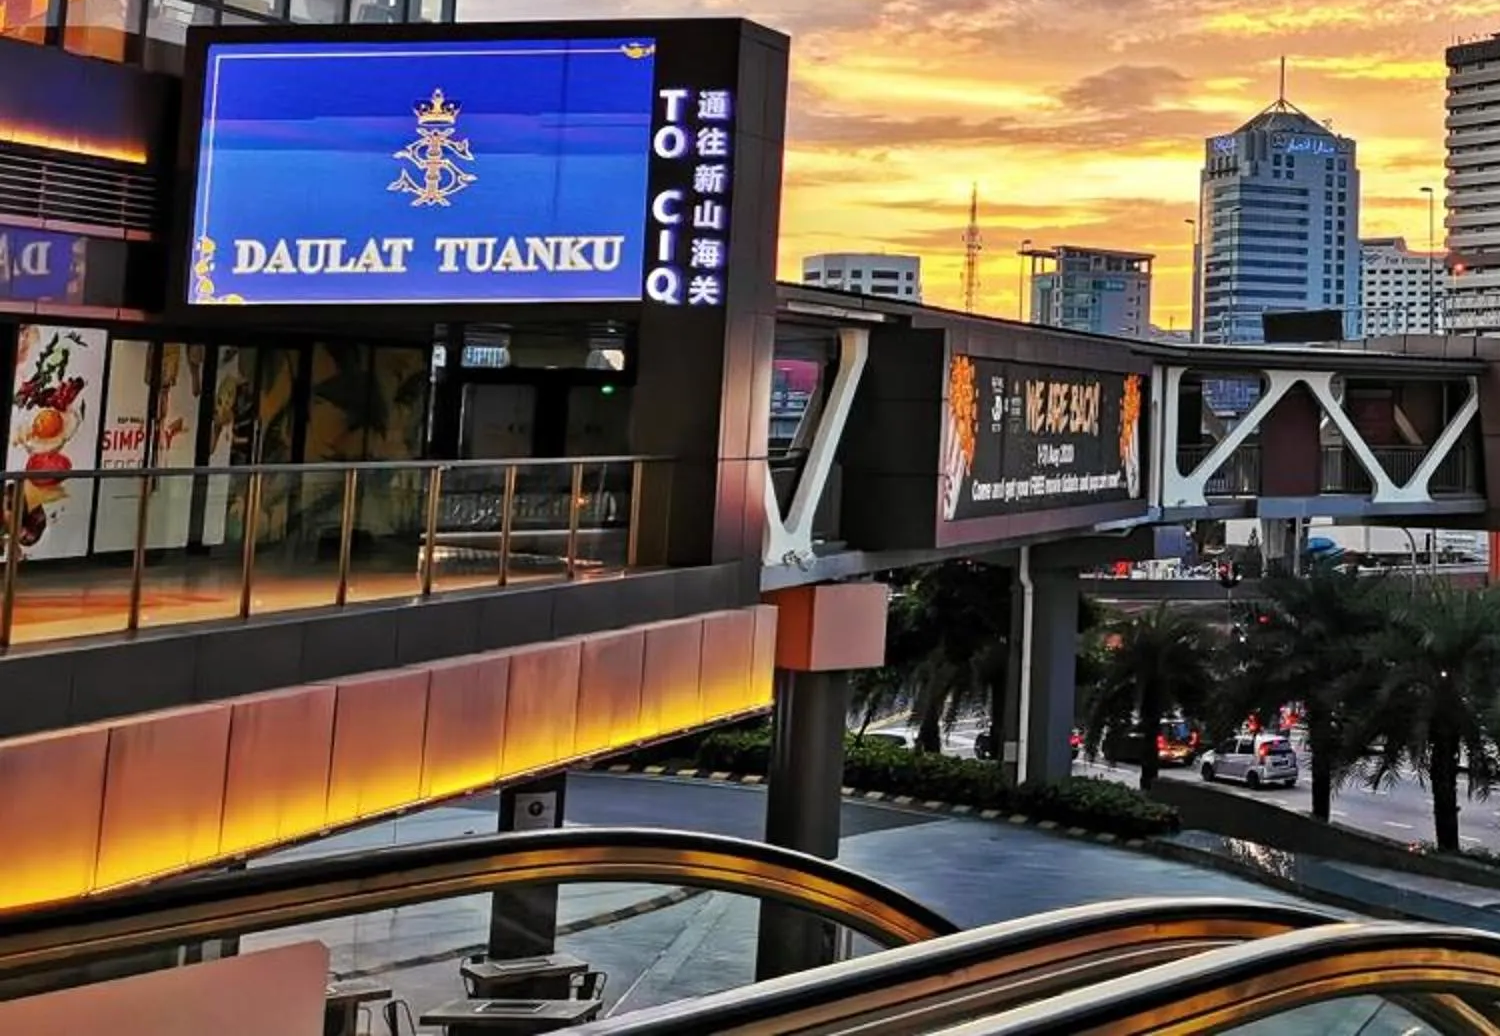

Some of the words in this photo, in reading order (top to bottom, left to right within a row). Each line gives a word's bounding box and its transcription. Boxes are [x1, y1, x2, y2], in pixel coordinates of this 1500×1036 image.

[653, 89, 688, 158] TO
[687, 90, 730, 305] 通往新山海关
[232, 237, 414, 275] DAULAT
[434, 235, 625, 273] TUANKU
[646, 190, 682, 304] CIQ
[1025, 379, 1045, 435] WE
[971, 478, 991, 501] Come
[1030, 475, 1046, 495] FREE
